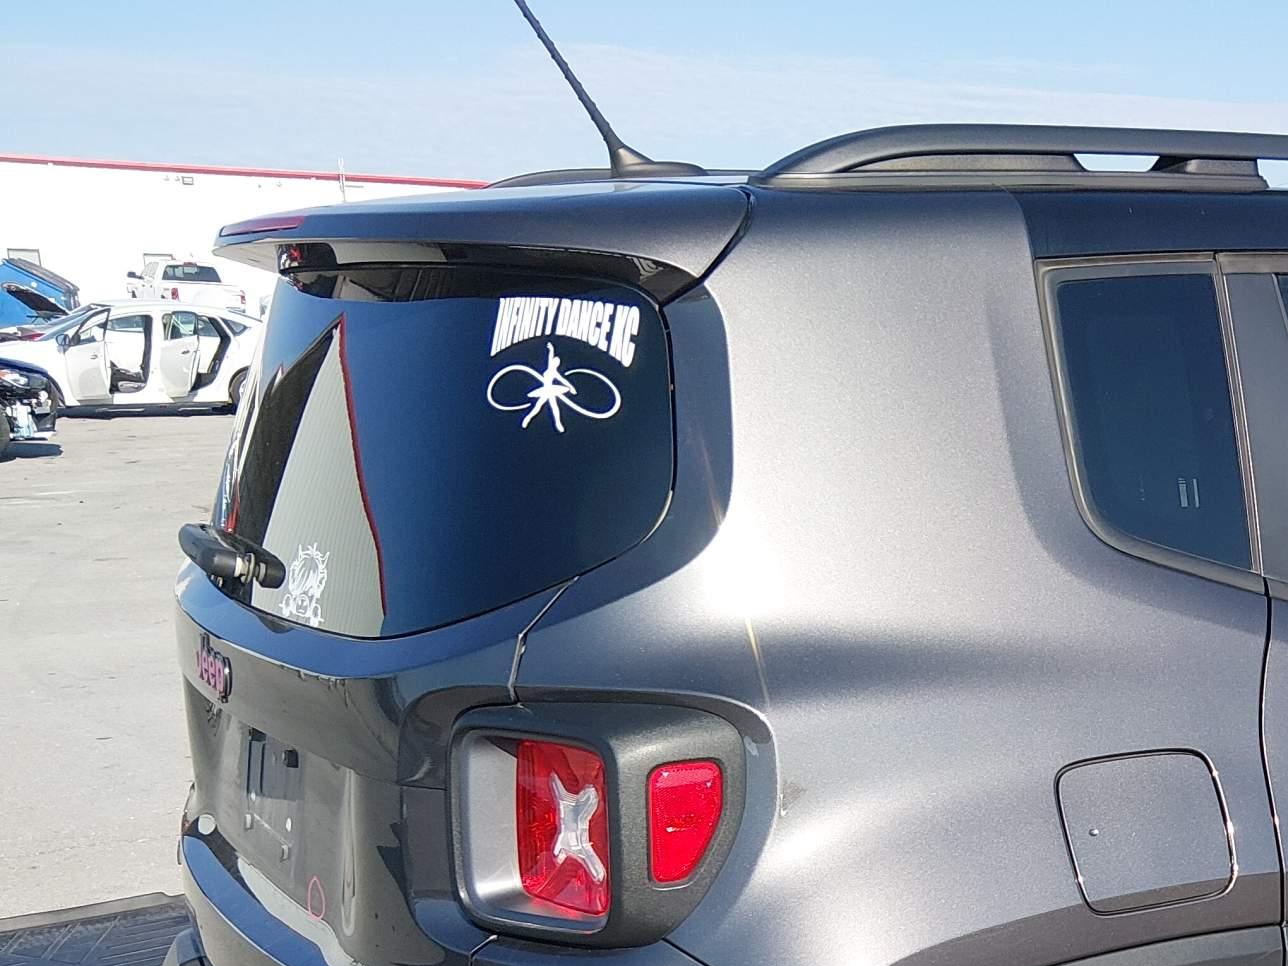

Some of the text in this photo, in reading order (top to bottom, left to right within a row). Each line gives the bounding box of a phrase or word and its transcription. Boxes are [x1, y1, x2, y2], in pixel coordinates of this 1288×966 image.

[490, 297, 640, 367] INFINITY DANCE KC
[195, 632, 232, 703] Jeep
